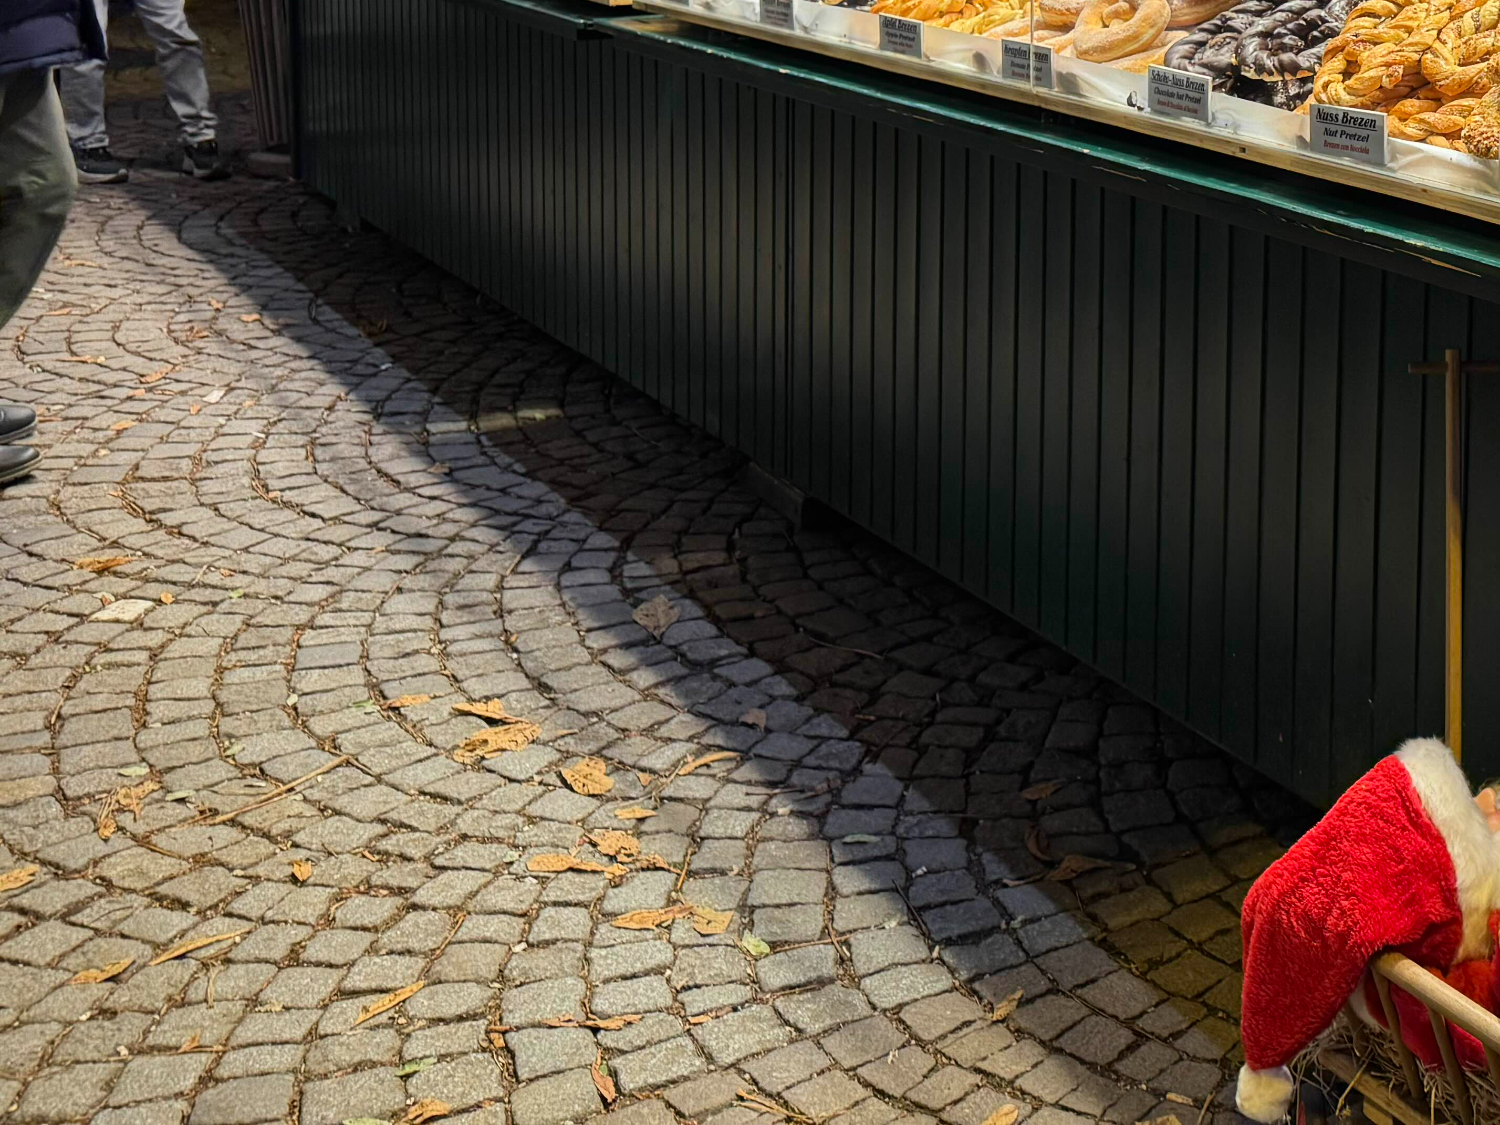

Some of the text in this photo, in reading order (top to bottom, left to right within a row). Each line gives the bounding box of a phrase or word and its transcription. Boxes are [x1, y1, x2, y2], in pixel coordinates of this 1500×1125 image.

[1185, 77, 1205, 92] Brezen
[1316, 108, 1377, 129] Nuss Brezen
[1323, 127, 1370, 143] Nut Pretzel
